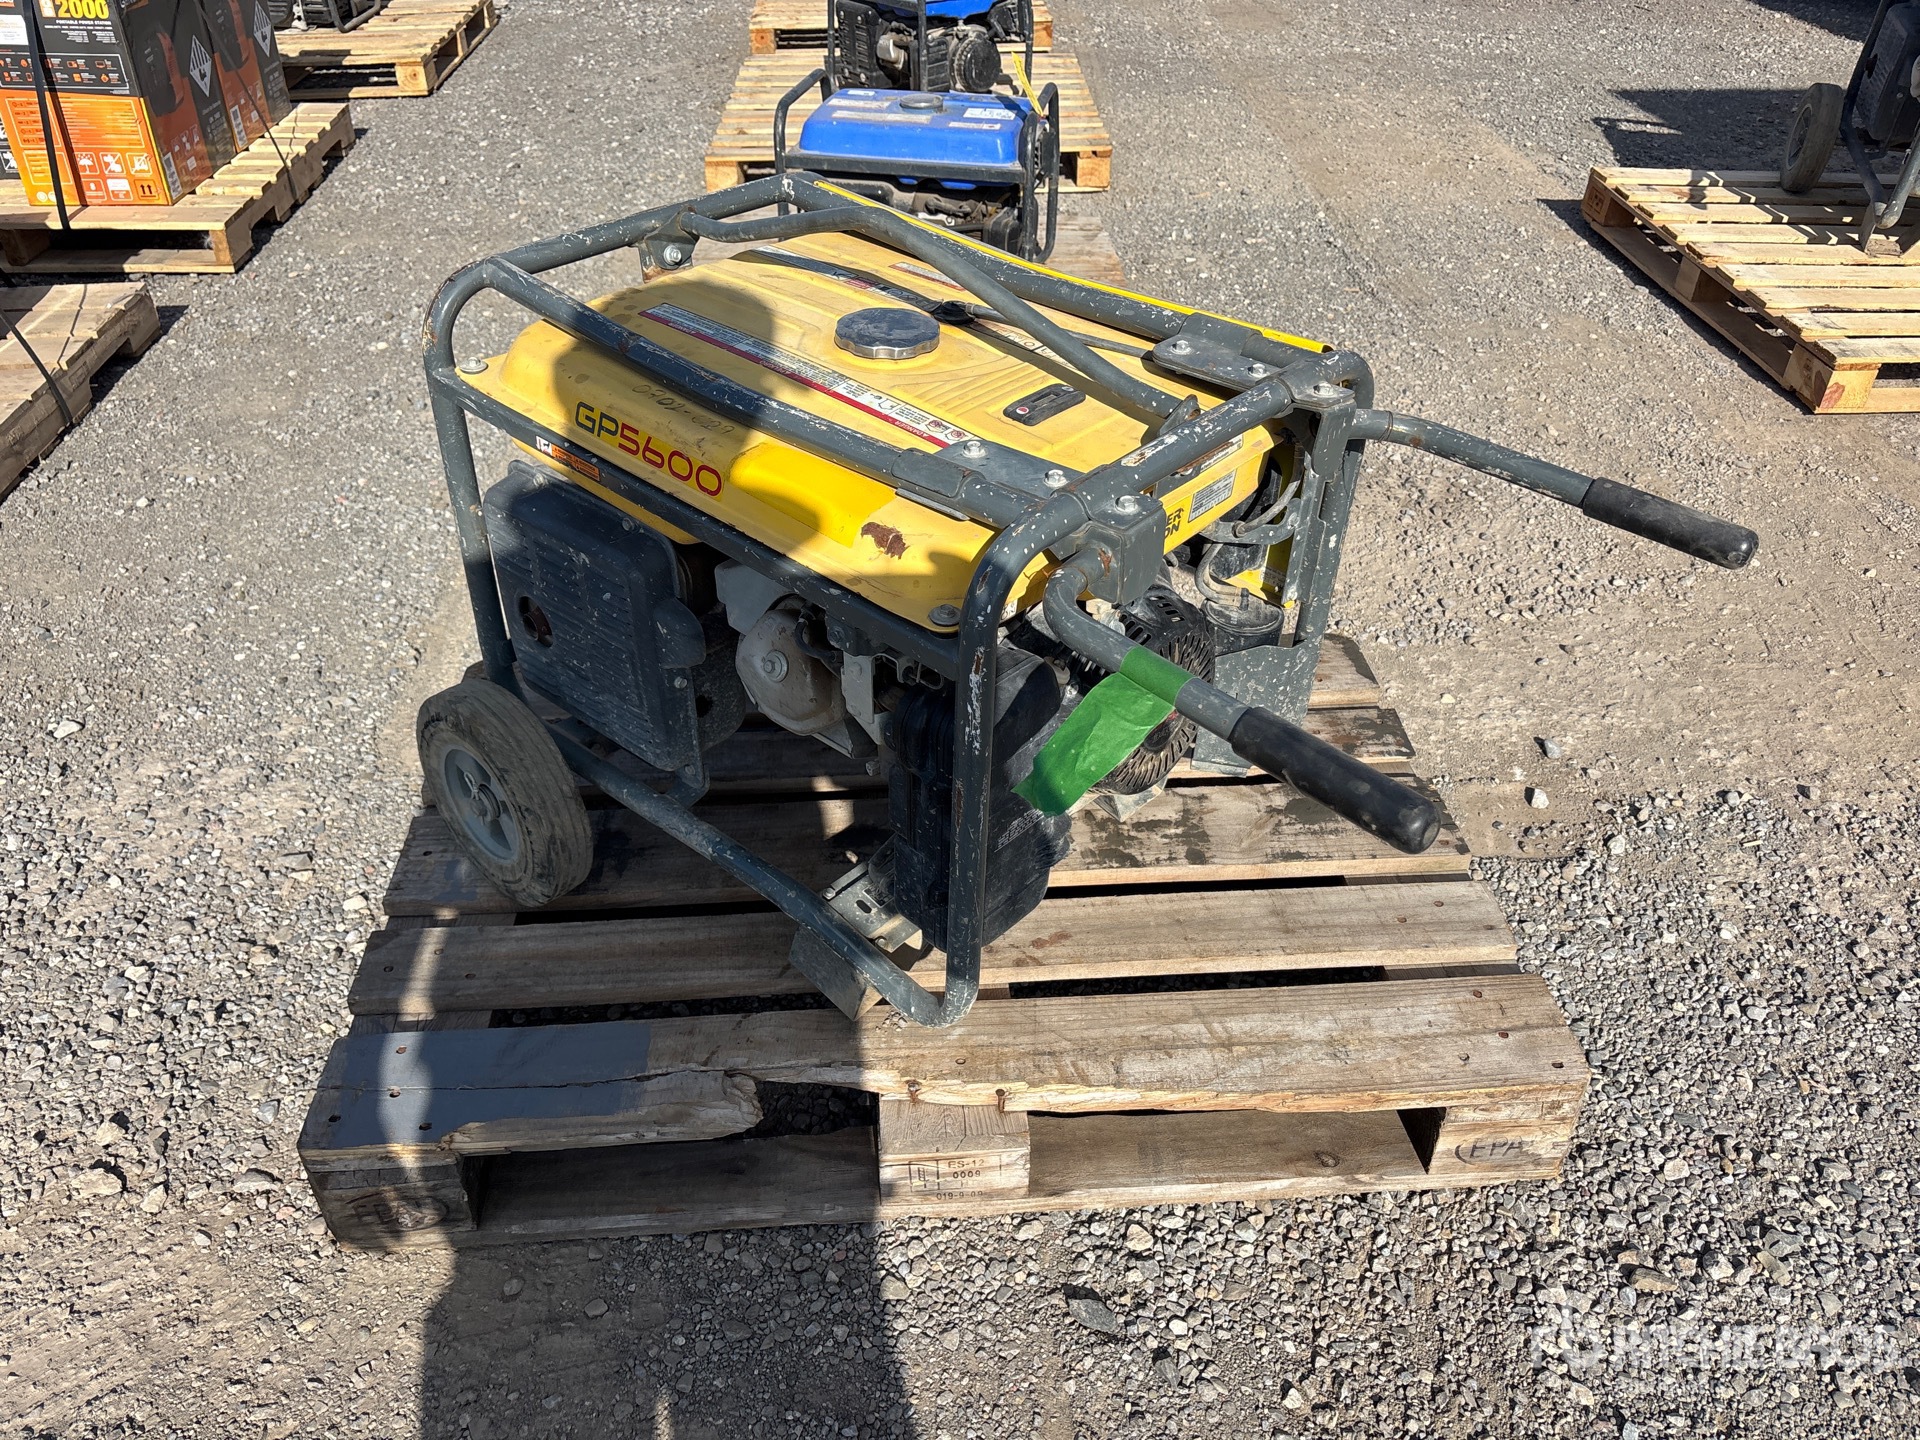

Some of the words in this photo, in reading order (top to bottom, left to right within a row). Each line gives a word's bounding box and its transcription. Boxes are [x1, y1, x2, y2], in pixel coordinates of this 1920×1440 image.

[55, 0, 110, 19] 2000
[894, 420, 923, 437] DANGER
[575, 401, 722, 497] GP5600
[952, 1169, 981, 1179] 0009
